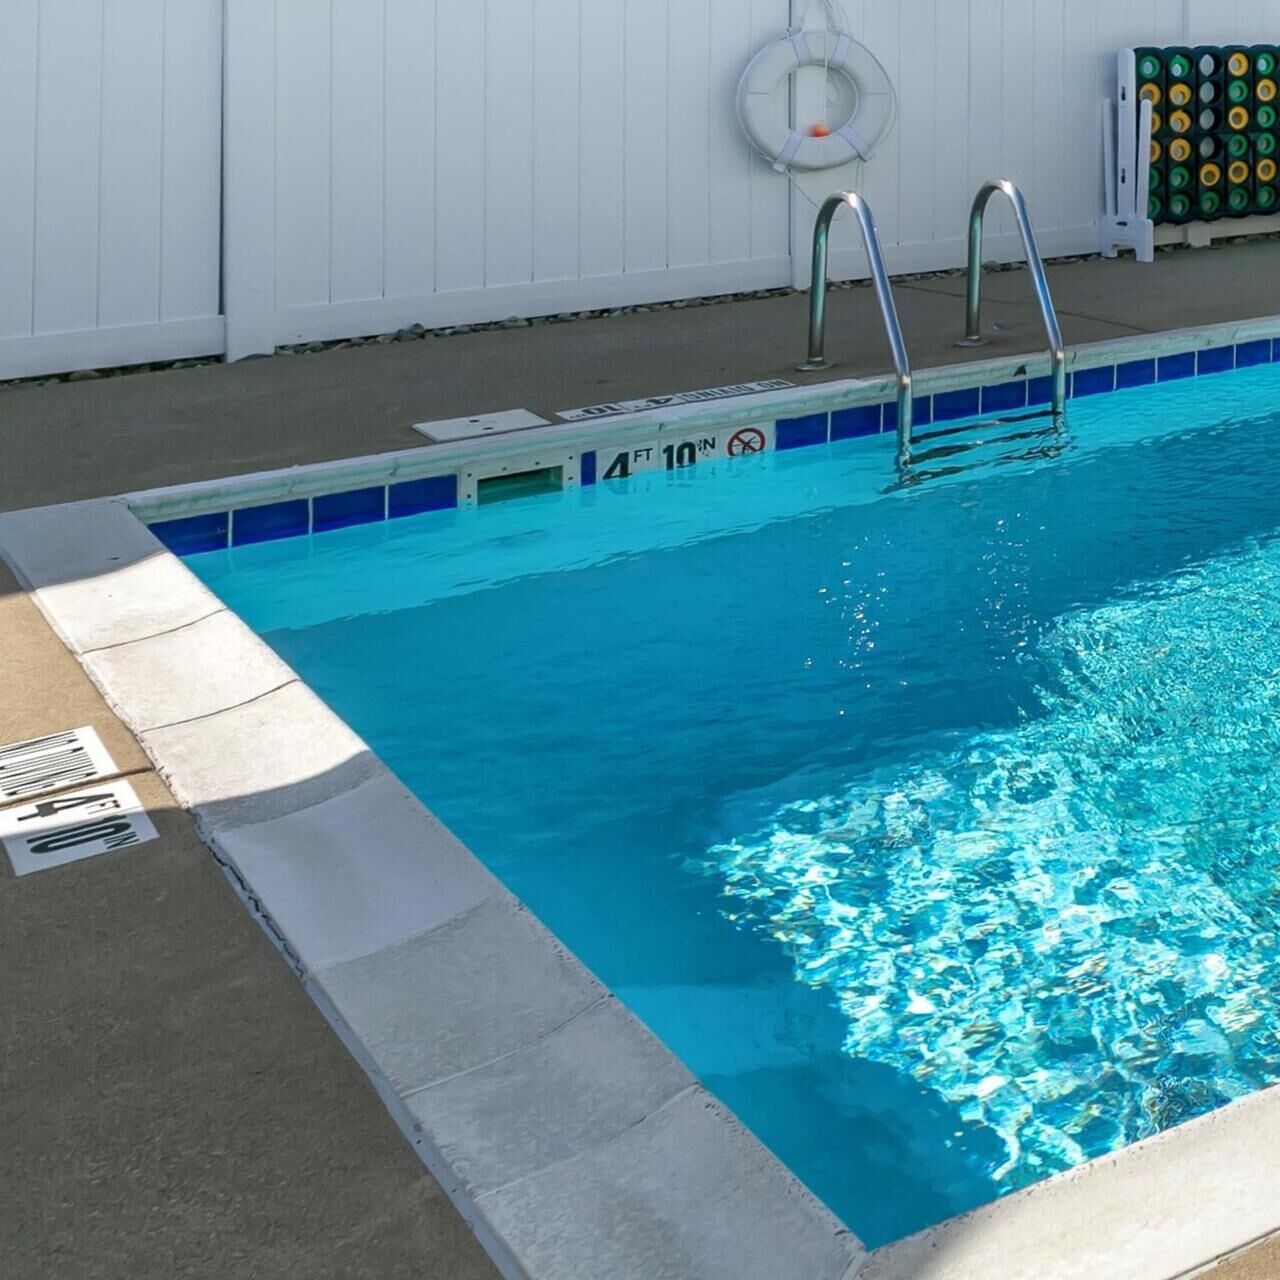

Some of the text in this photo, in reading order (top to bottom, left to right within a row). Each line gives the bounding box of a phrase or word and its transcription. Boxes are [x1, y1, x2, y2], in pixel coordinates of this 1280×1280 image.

[682, 384, 756, 400] DIVING
[757, 379, 790, 389] NO
[602, 451, 633, 480] 4
[633, 447, 654, 463] FT
[662, 441, 697, 472] 10
[17, 792, 116, 822] 4
[26, 814, 140, 854] 10 IN
